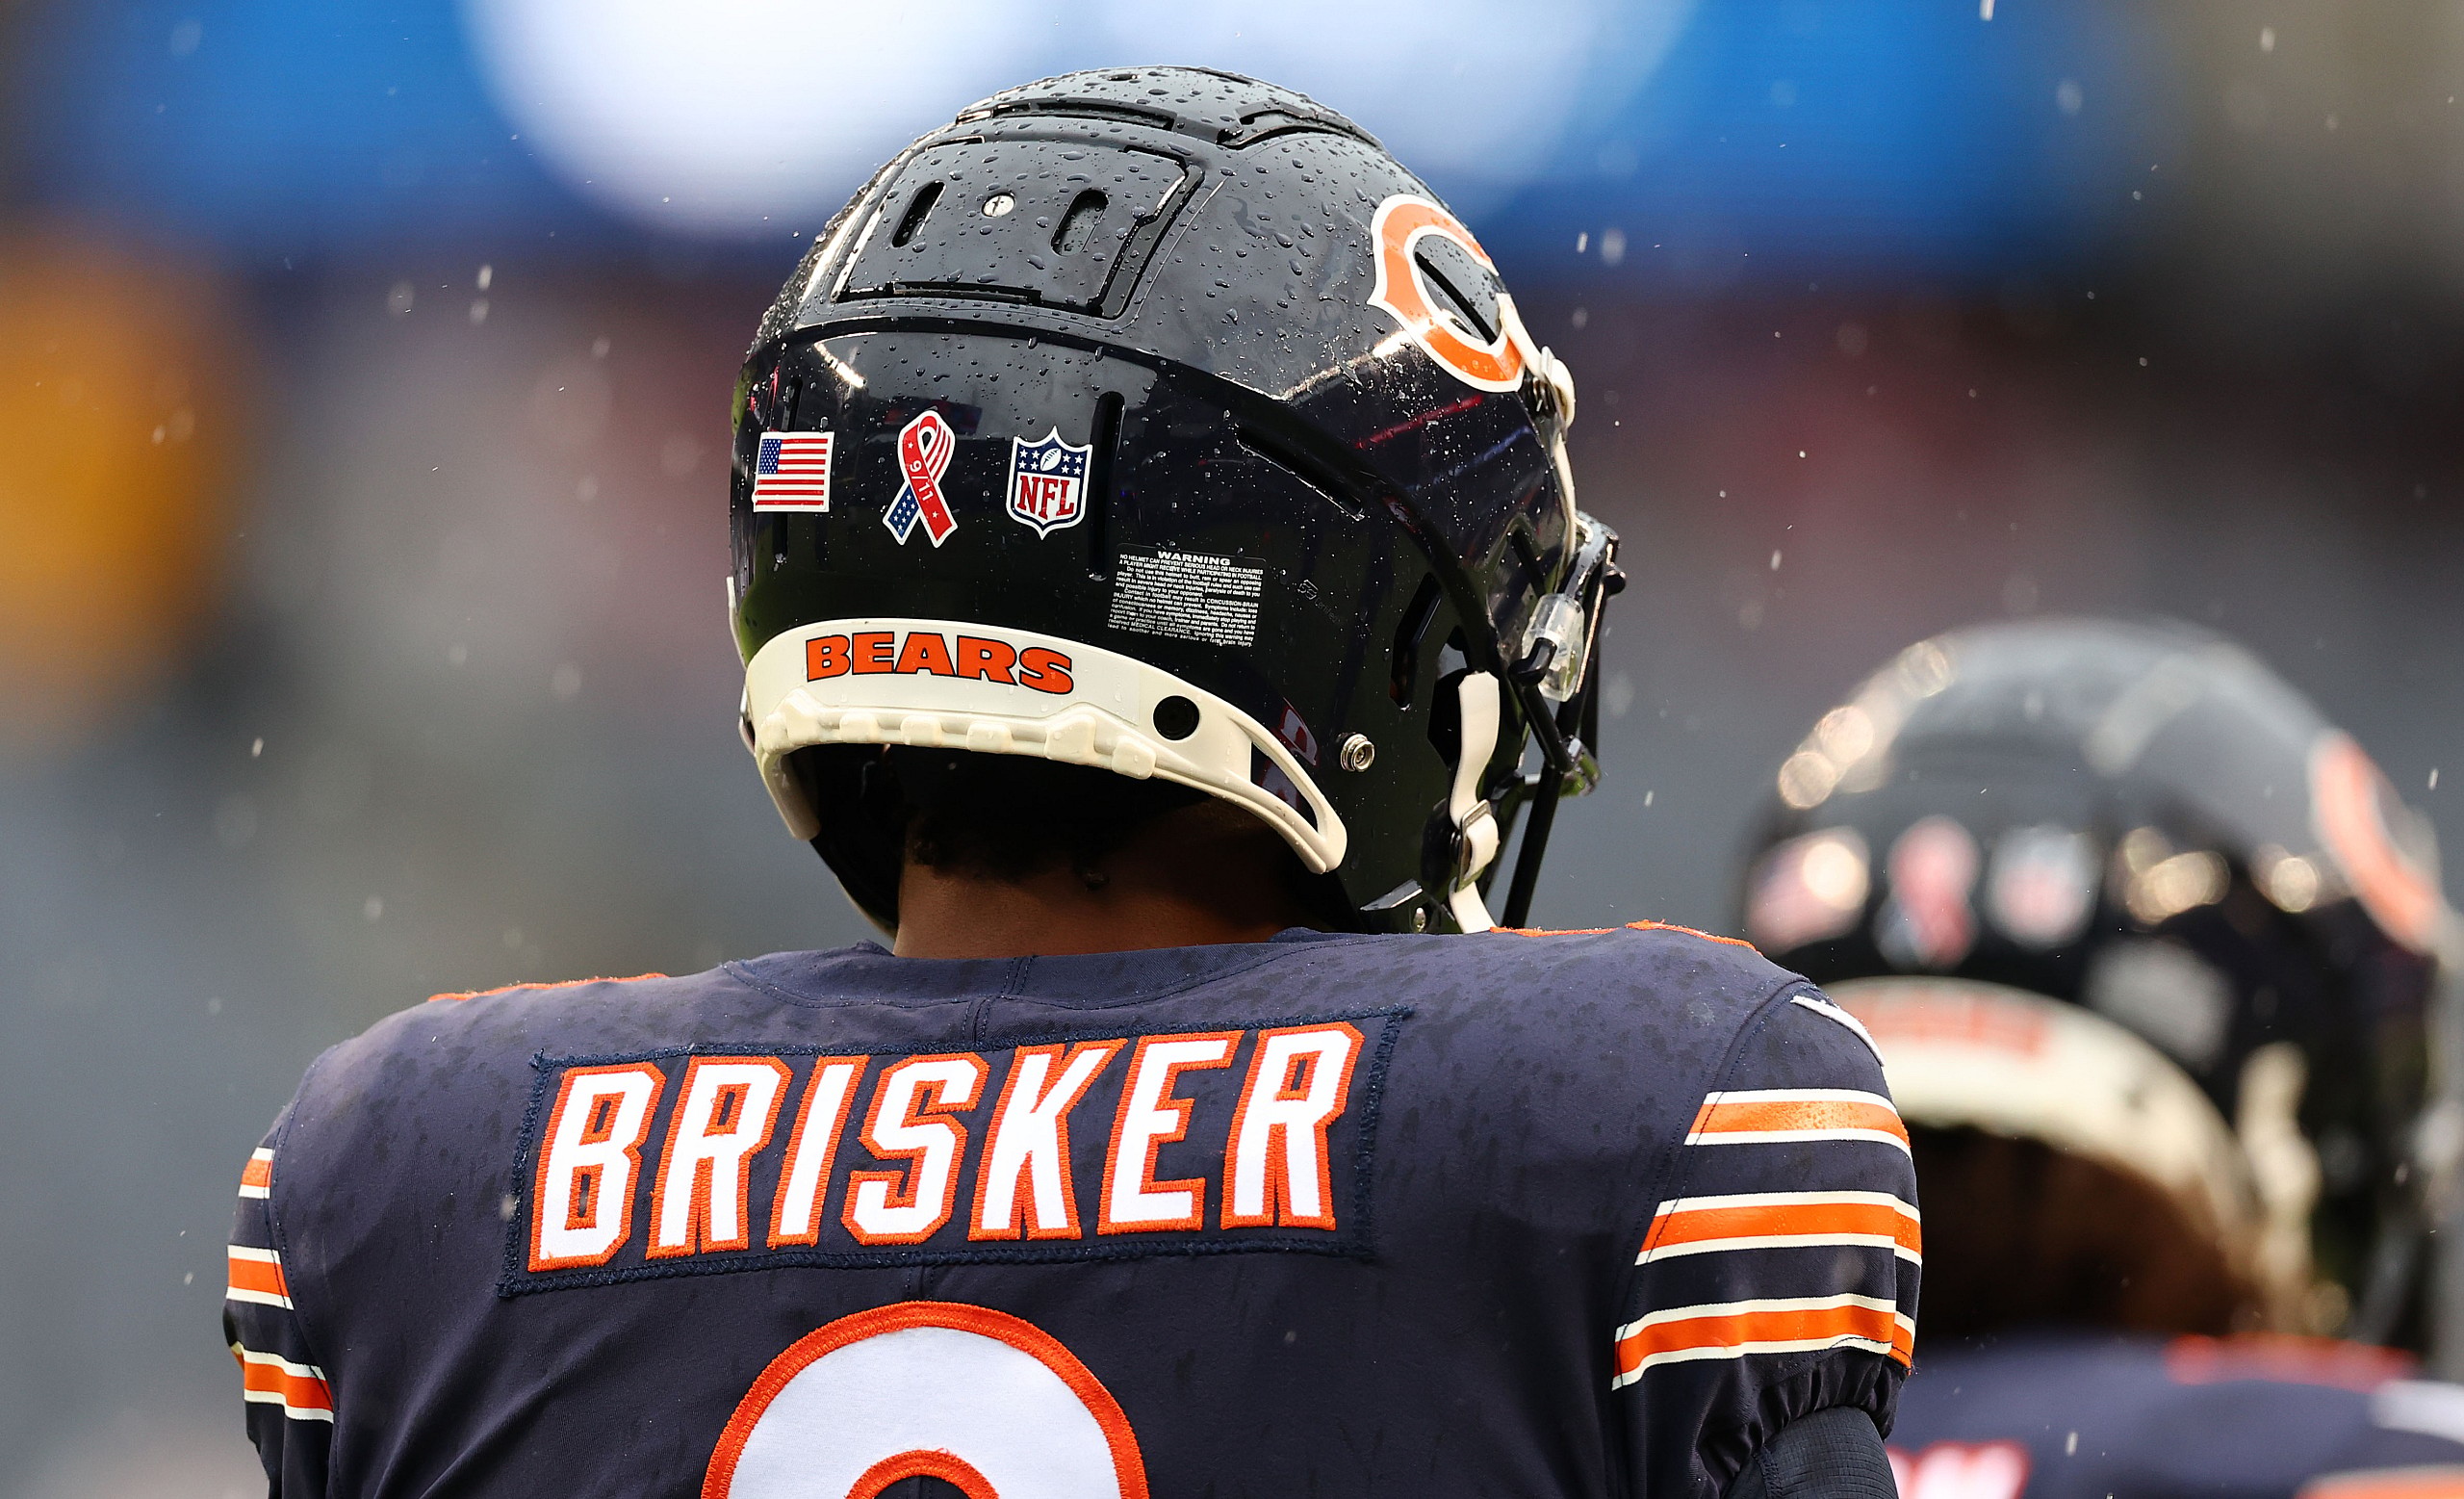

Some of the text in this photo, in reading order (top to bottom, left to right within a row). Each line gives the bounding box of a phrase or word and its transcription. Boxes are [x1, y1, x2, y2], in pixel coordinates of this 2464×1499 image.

[1368, 194, 1524, 393] C
[910, 459, 933, 503] 9/11
[1016, 476, 1076, 520] NFL
[1157, 551, 1231, 566] WARNING
[806, 632, 1074, 695] BEARS
[527, 1021, 1363, 1272] BRISKER
